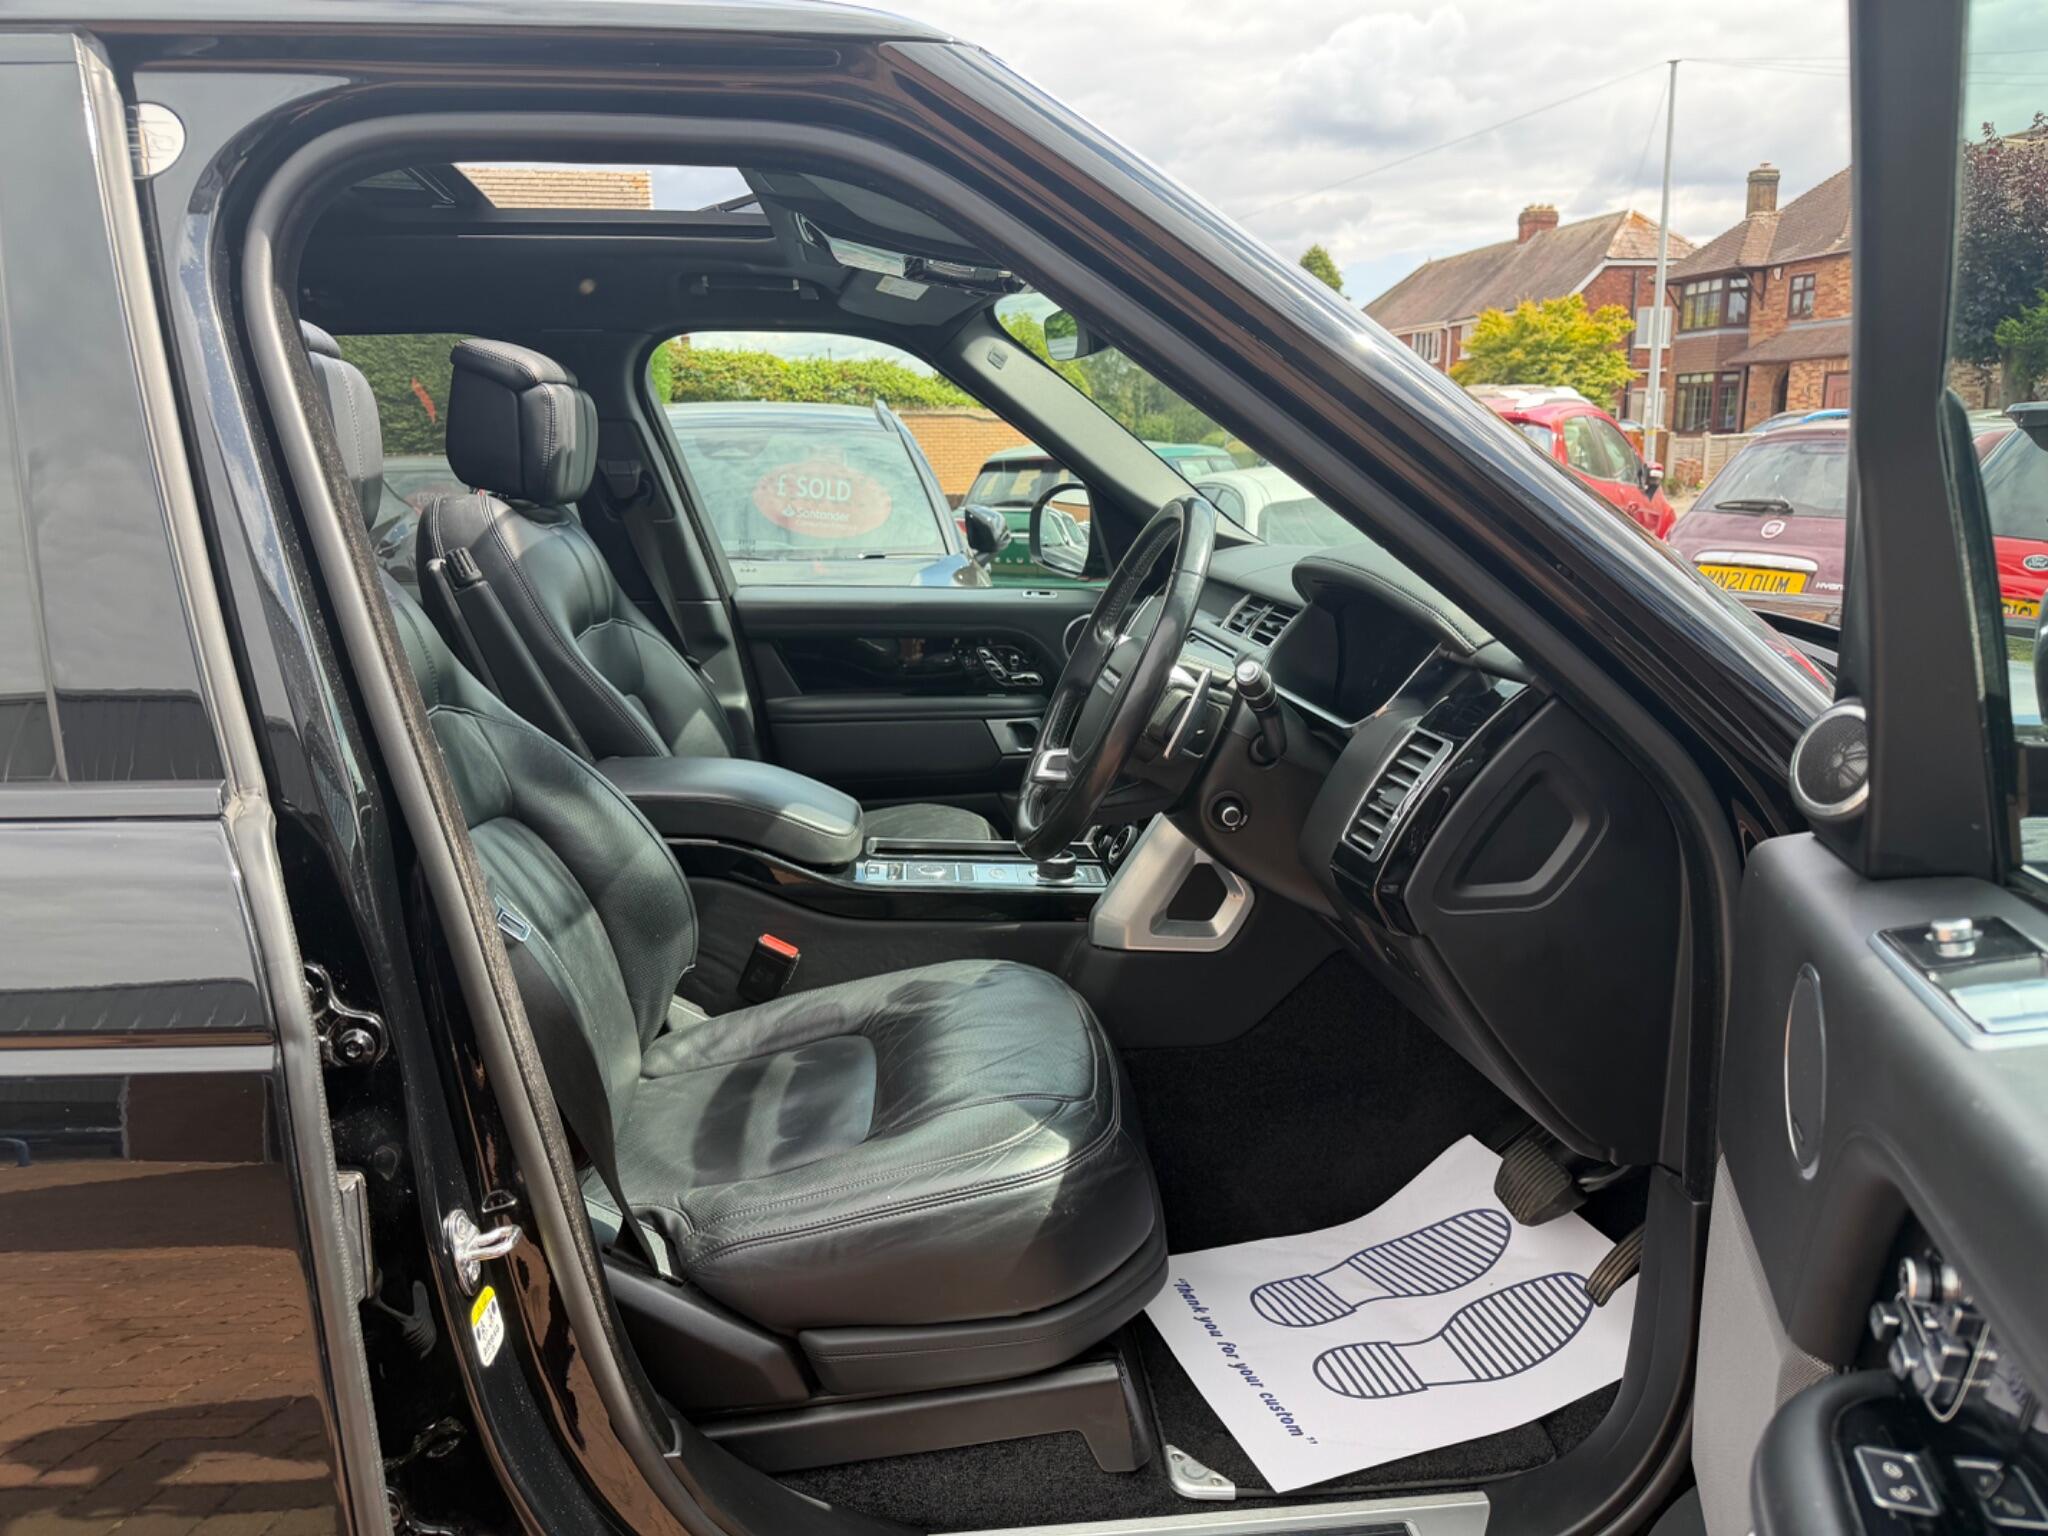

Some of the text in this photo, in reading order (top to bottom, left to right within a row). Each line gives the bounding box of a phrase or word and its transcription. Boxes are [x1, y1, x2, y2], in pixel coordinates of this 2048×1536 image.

[796, 475, 852, 501] SOLD
[1193, 1316, 1223, 1337] you
[1216, 1341, 1240, 1360] for
[1227, 1362, 1264, 1388] your
